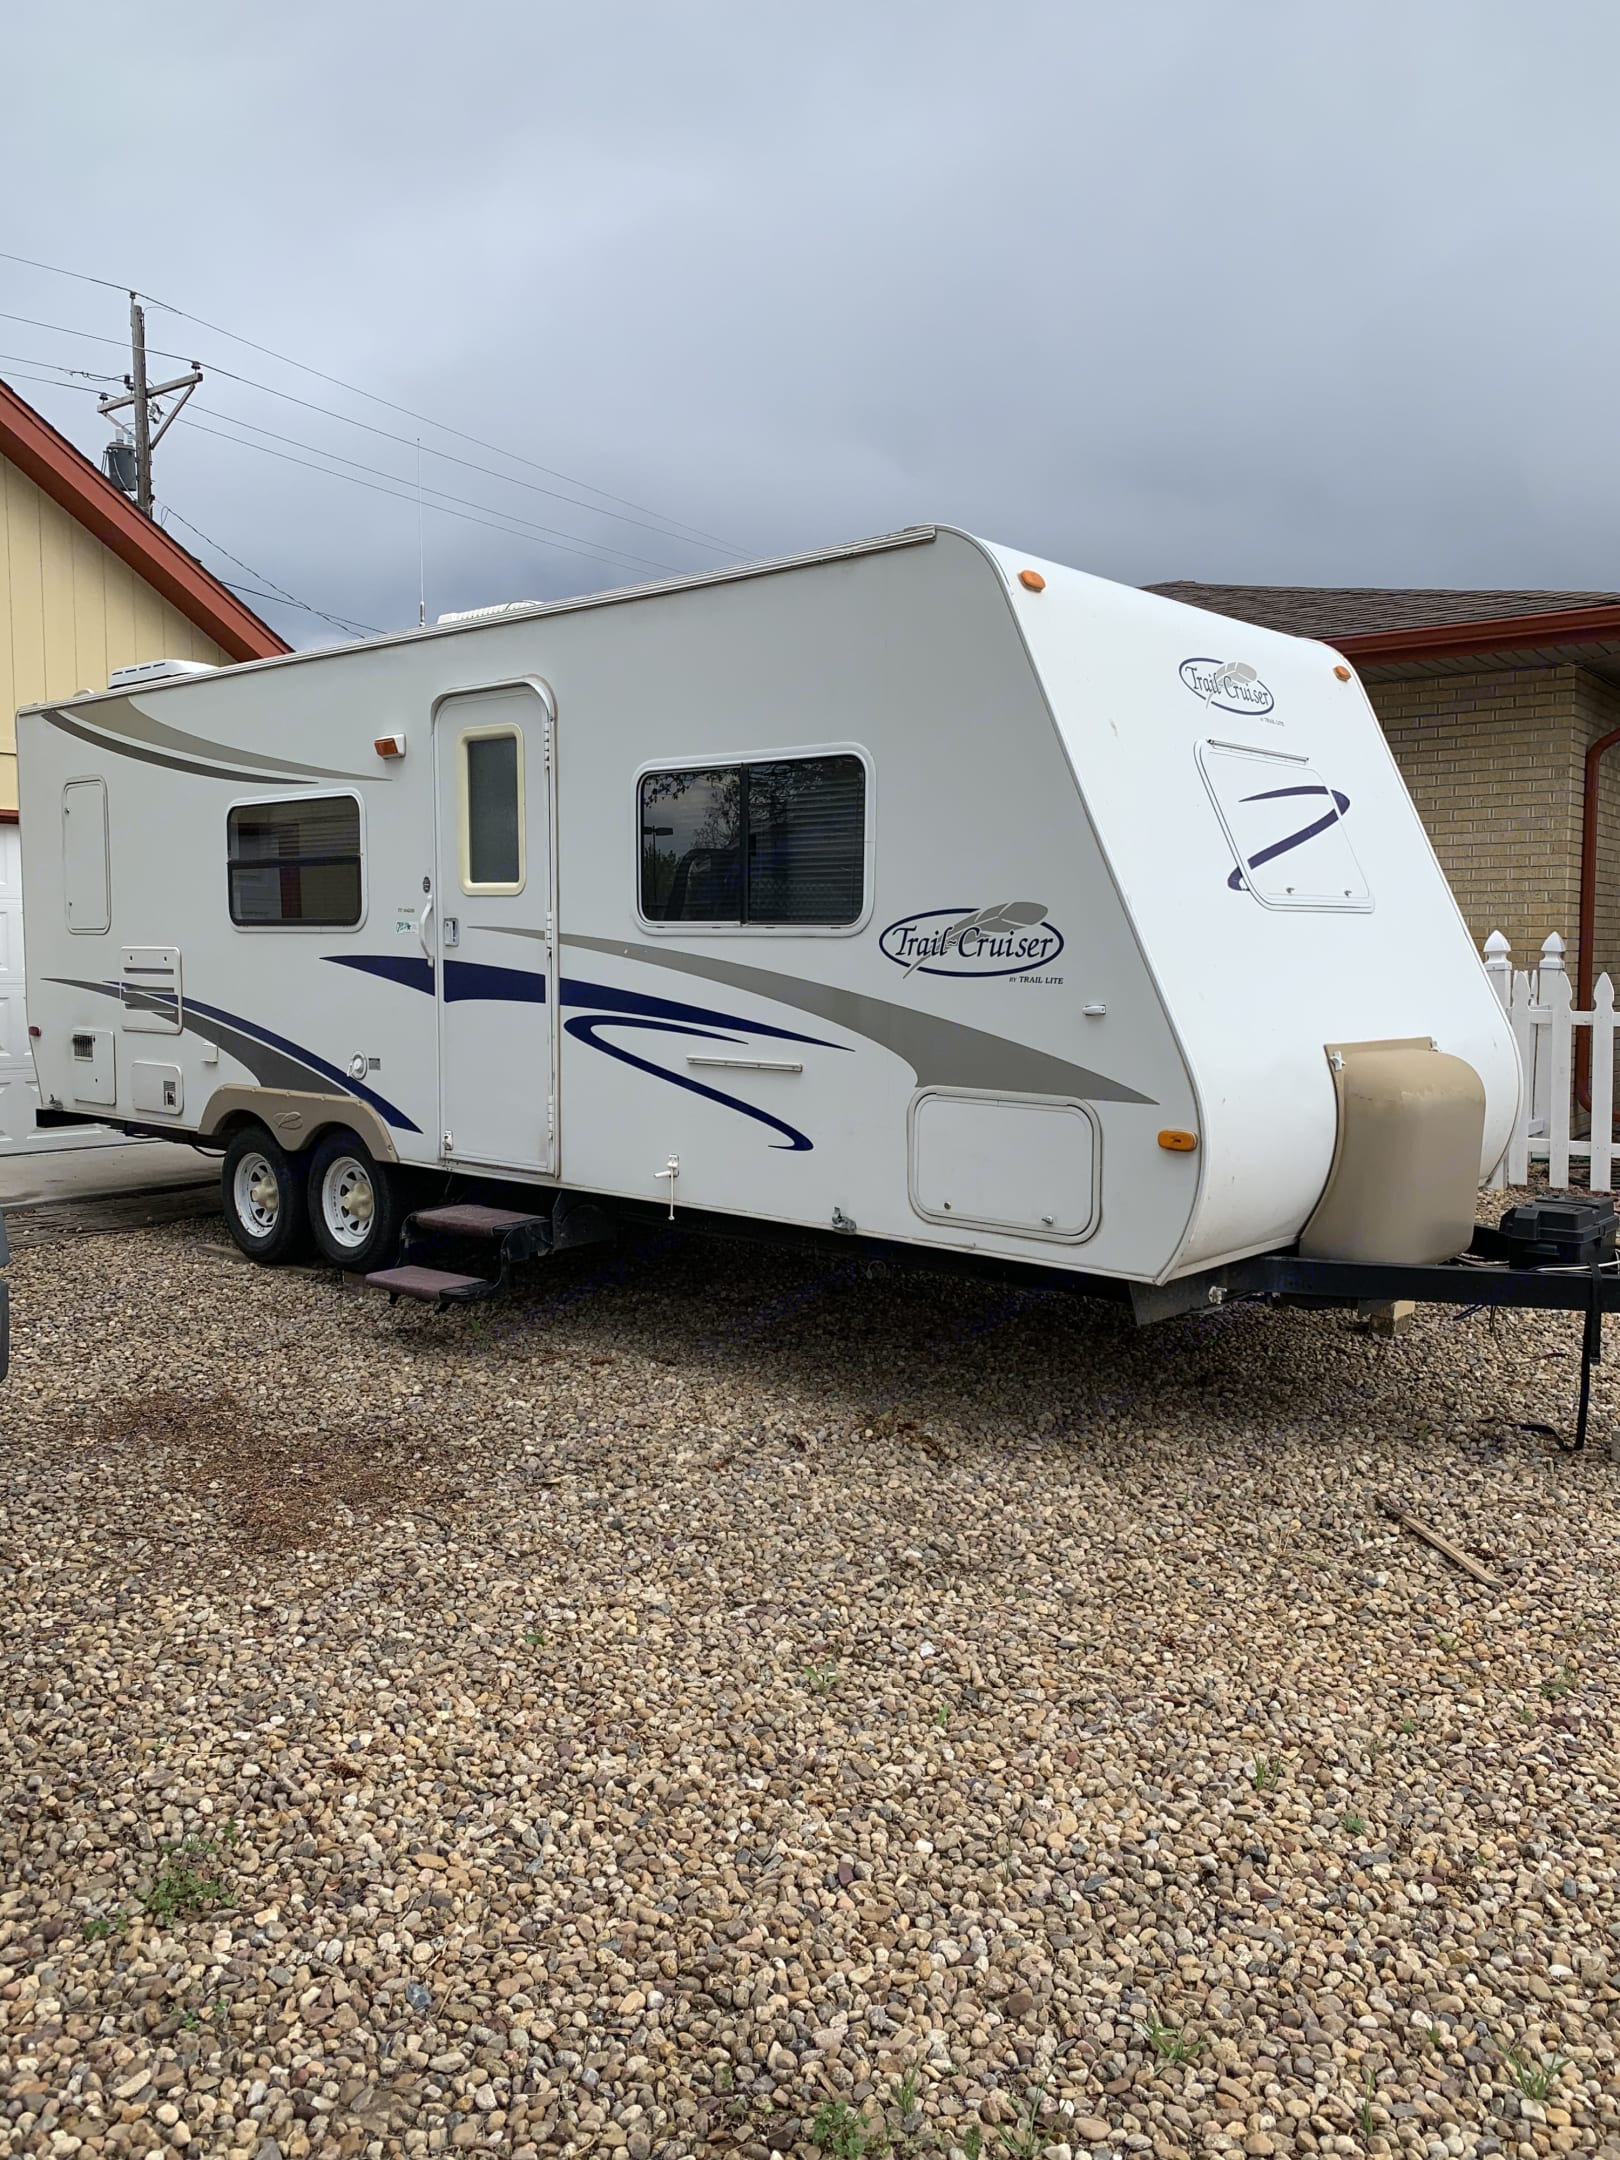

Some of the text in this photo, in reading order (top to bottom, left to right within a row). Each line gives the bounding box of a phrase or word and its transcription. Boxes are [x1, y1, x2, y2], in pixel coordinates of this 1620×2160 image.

[1223, 675, 1269, 706] Cruiser
[958, 926, 1054, 958] Cruiser
[1019, 975, 1043, 985] TRAIL
[1045, 976, 1064, 985] LITE
